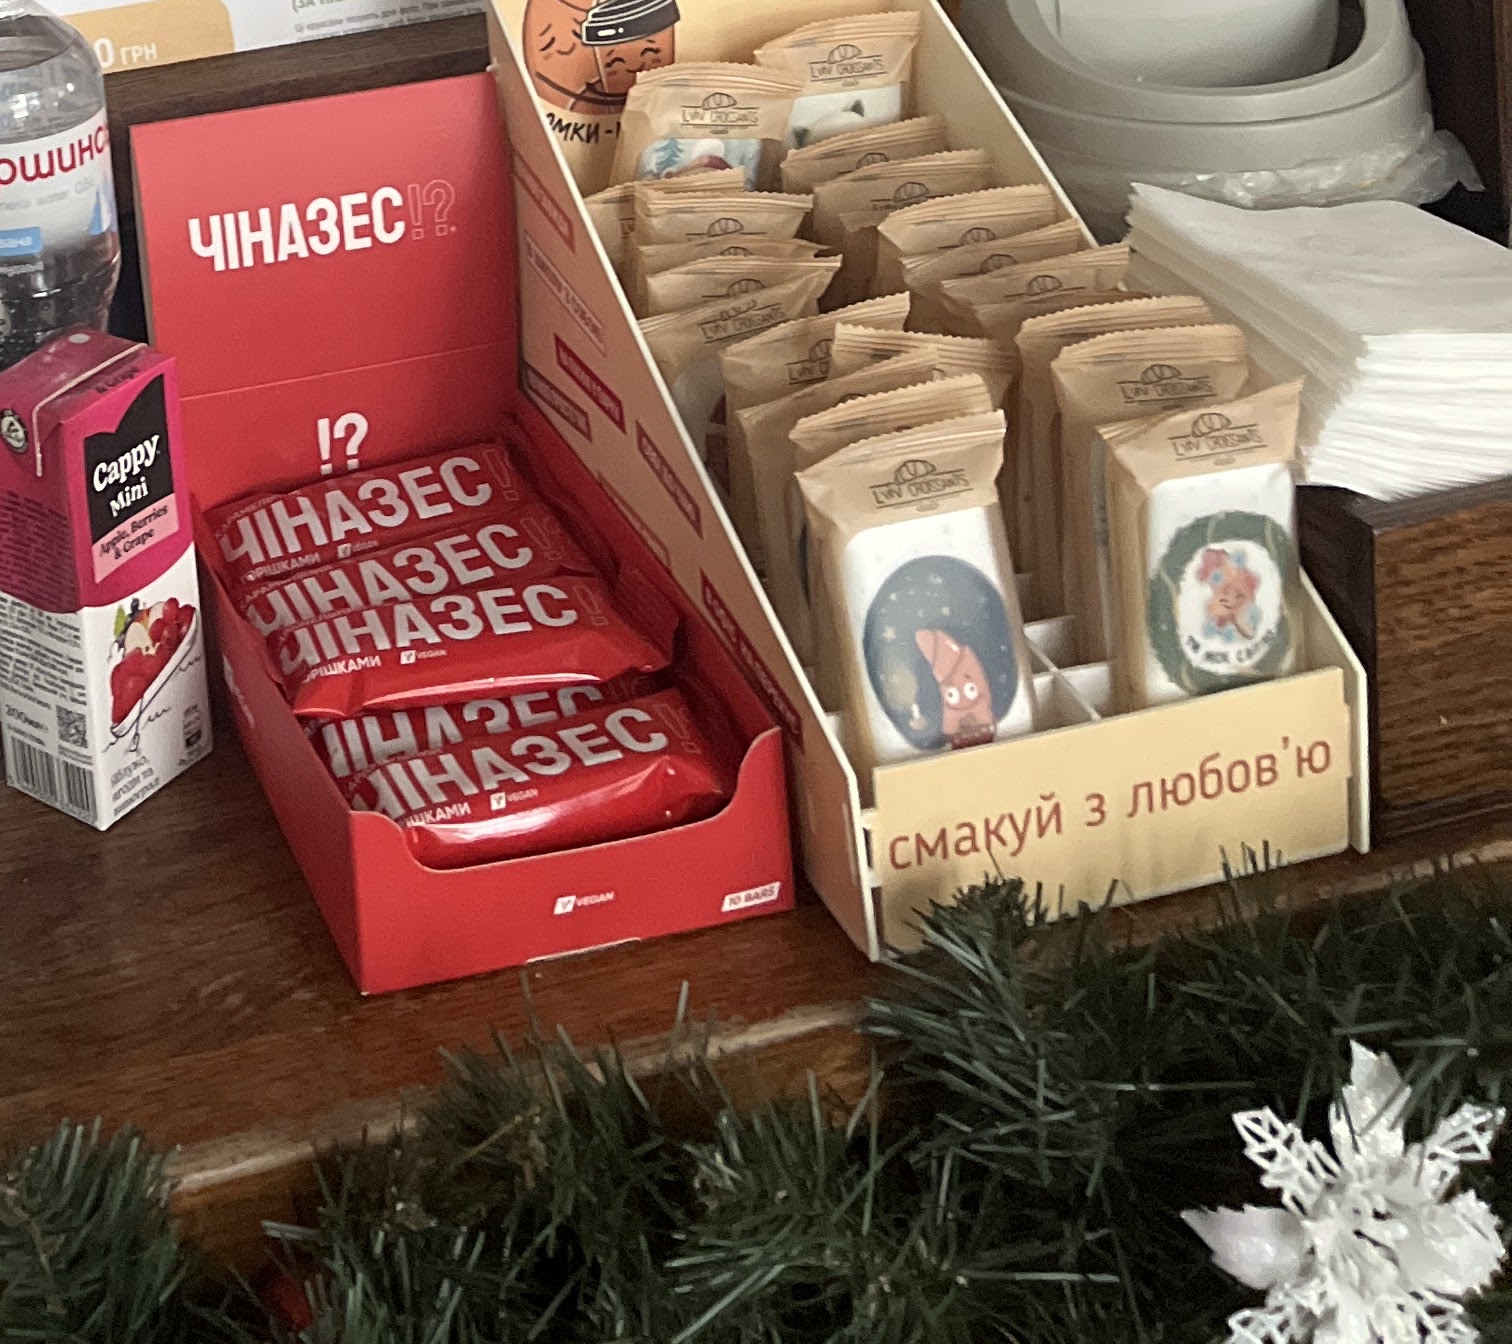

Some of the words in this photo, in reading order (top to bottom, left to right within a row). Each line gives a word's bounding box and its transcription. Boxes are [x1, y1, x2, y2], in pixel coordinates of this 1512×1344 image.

[91, 430, 160, 492] Cappy
[108, 474, 150, 518] Mini
[888, 792, 1065, 872] смакуй
[1084, 796, 1108, 830] з
[1126, 736, 1333, 820] любов'ю
[726, 890, 744, 906] 10
